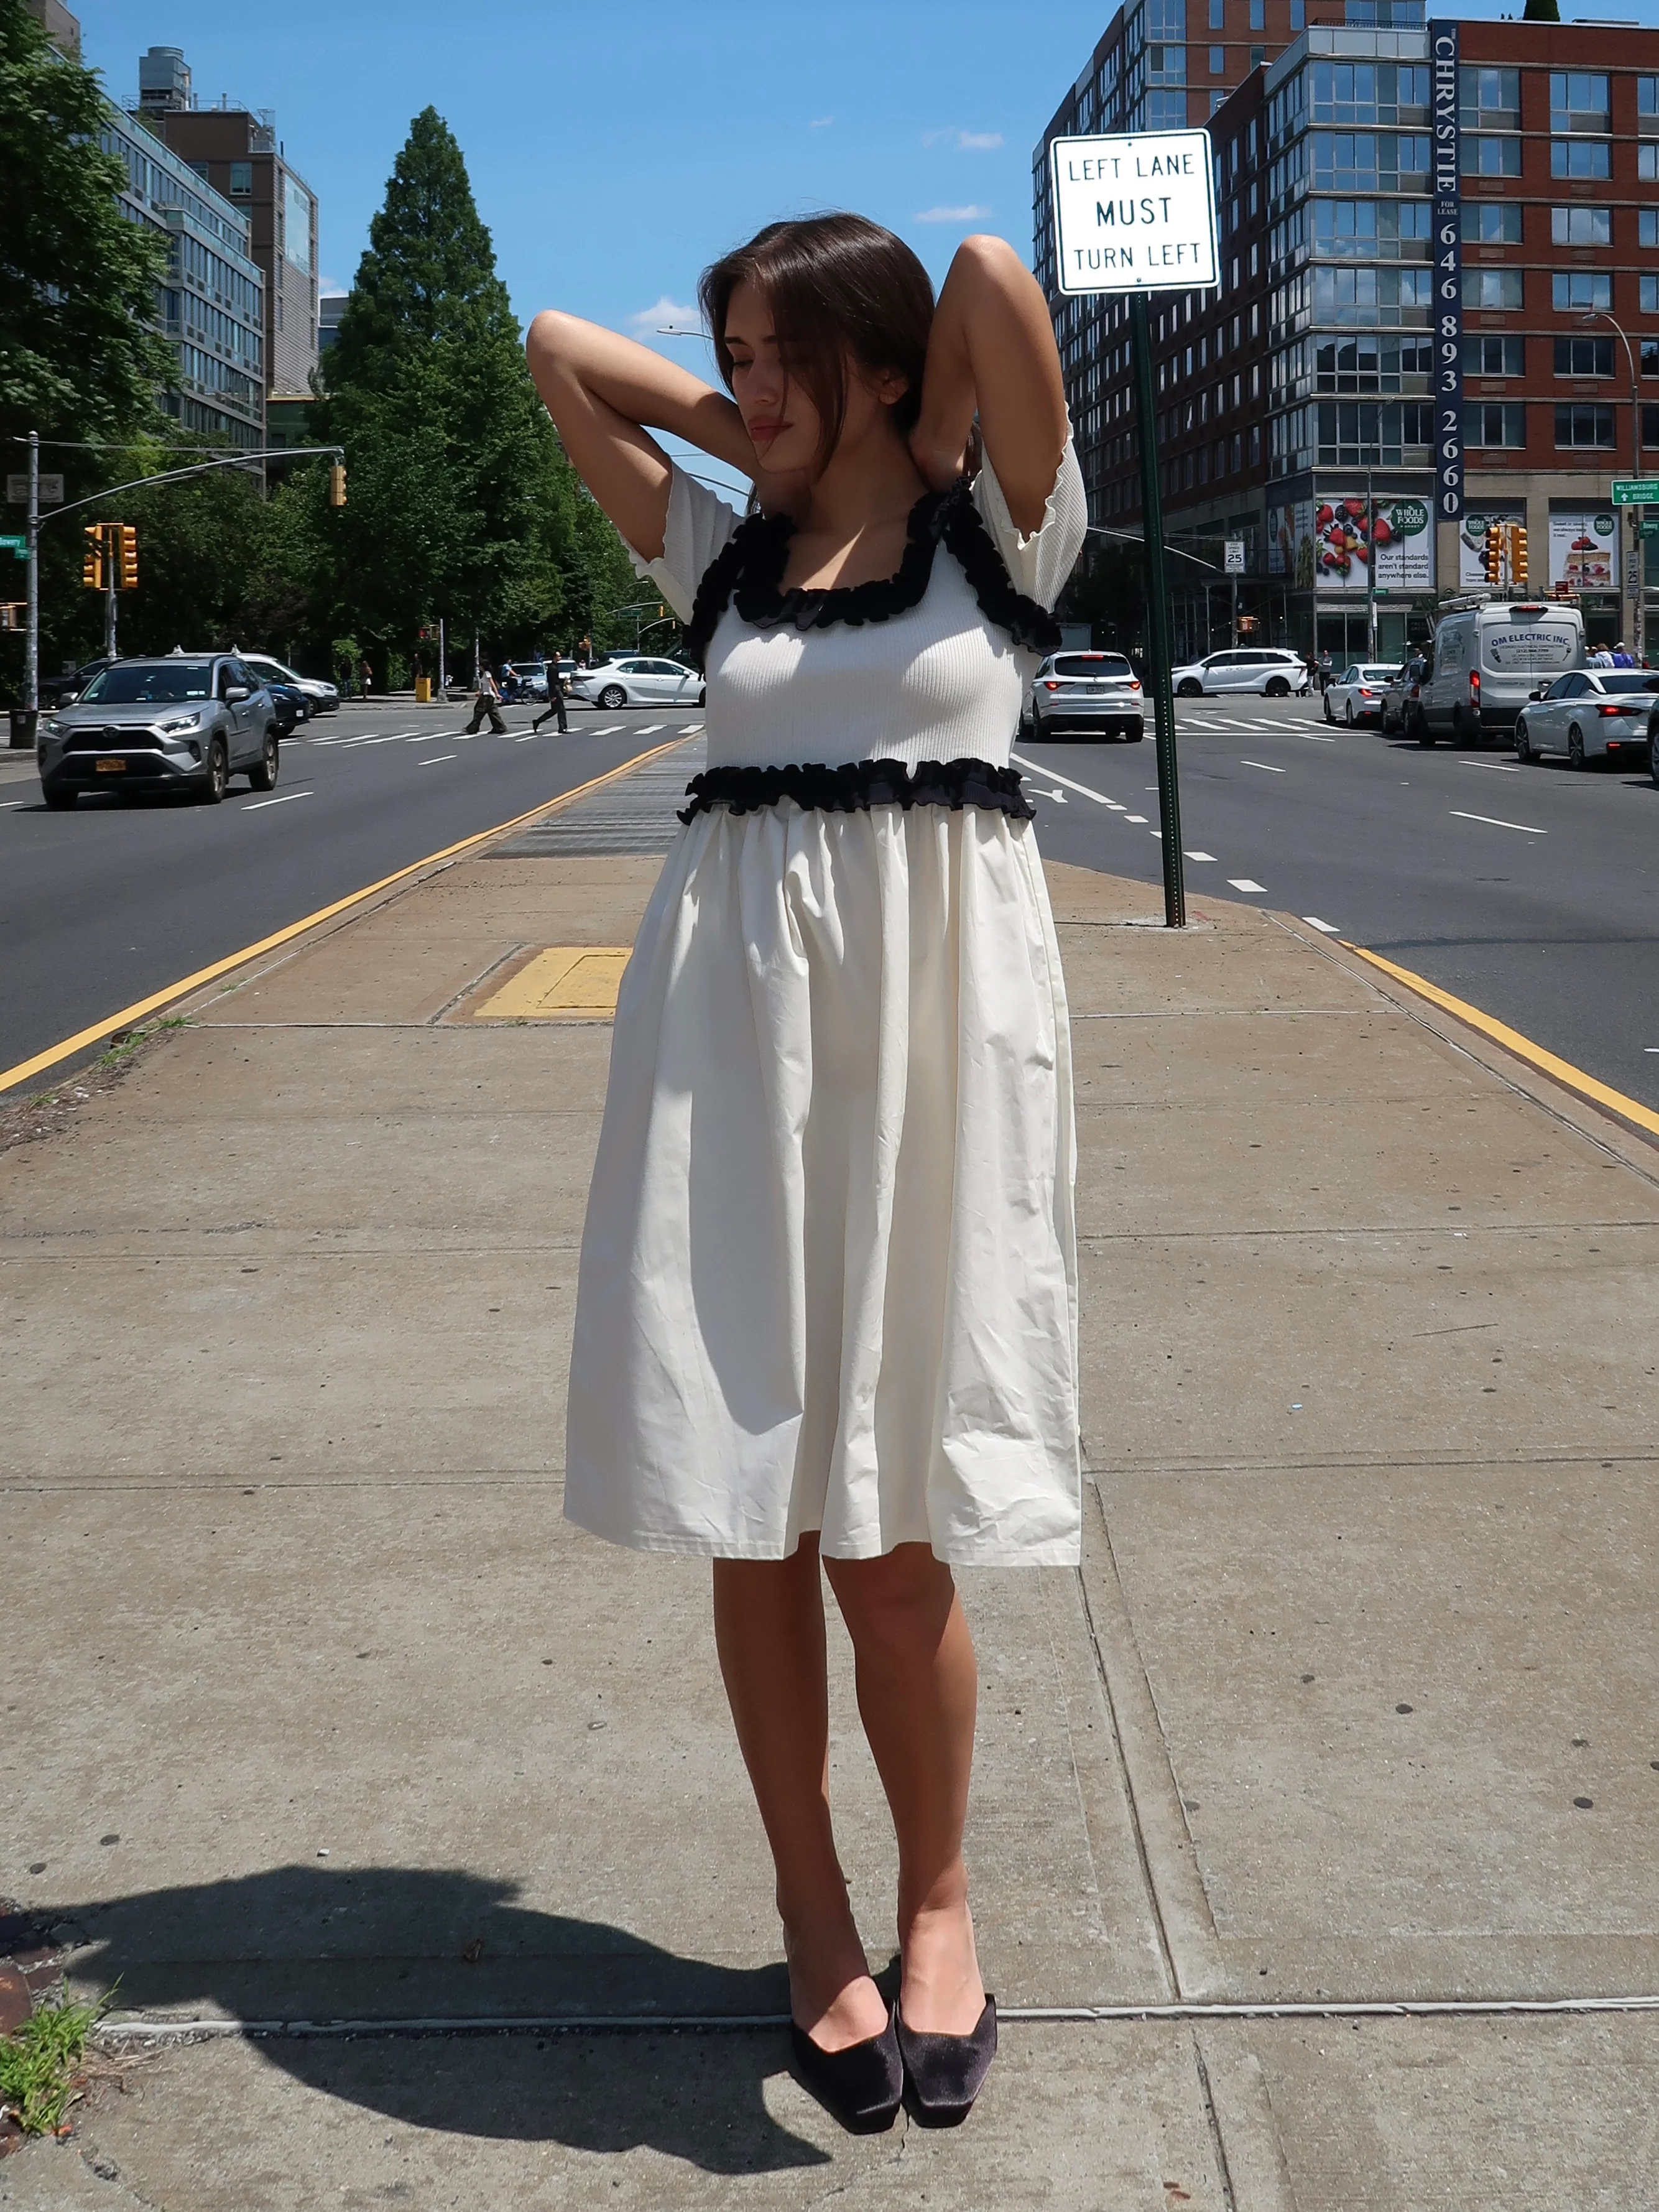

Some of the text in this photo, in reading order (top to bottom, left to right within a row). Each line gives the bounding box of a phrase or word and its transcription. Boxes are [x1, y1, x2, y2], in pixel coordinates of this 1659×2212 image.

[1435, 36, 1456, 192] CHRYSTIE
[1069, 154, 1195, 181] LEFT LANE
[1096, 197, 1171, 226] MUST
[1074, 243, 1200, 270] TURN LEFT
[1440, 223, 1459, 514] 646 893 2660
[1227, 554, 1242, 563] 25
[1628, 571, 1637, 583] 25
[1491, 637, 1507, 647] OM
[1509, 633, 1551, 642] ELECTRIC
